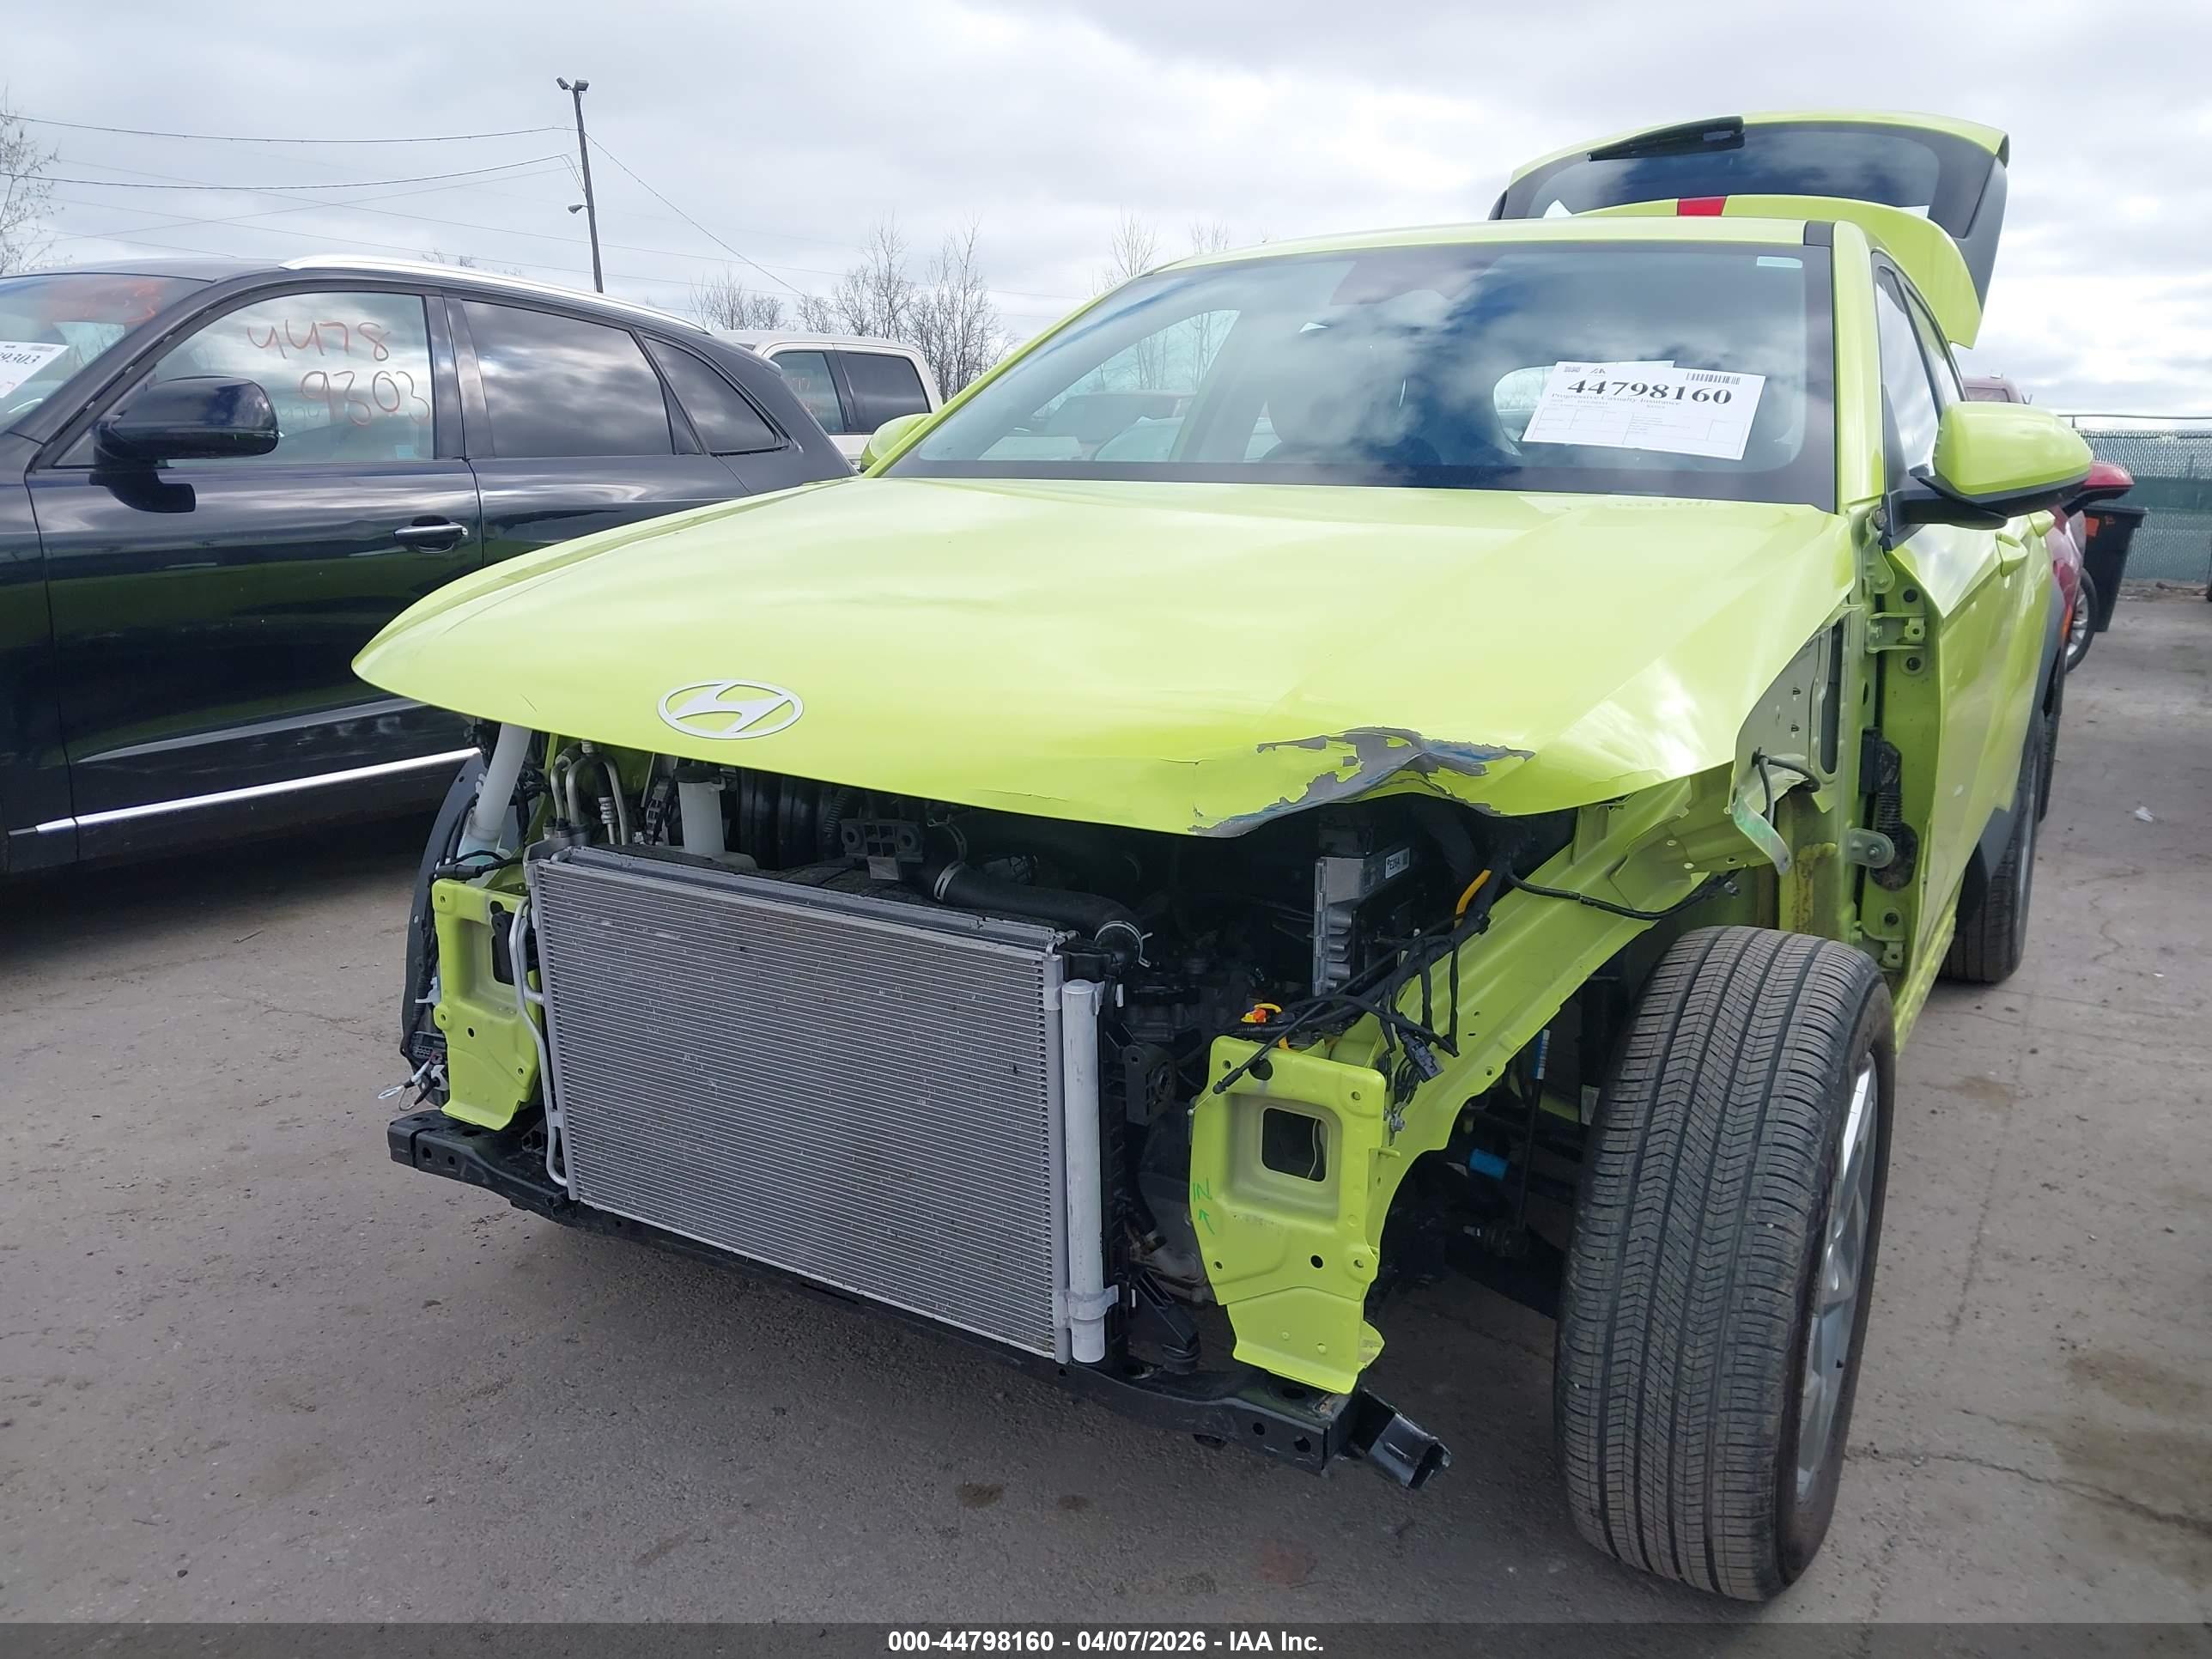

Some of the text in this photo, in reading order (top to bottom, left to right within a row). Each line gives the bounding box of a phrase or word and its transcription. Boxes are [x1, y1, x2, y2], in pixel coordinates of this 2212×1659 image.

[247, 319, 391, 362] 4478
[0, 352, 41, 365] 9303
[301, 370, 430, 426] 9303
[1552, 392, 1599, 401] Progressive
[1567, 379, 1732, 404] 44798160
